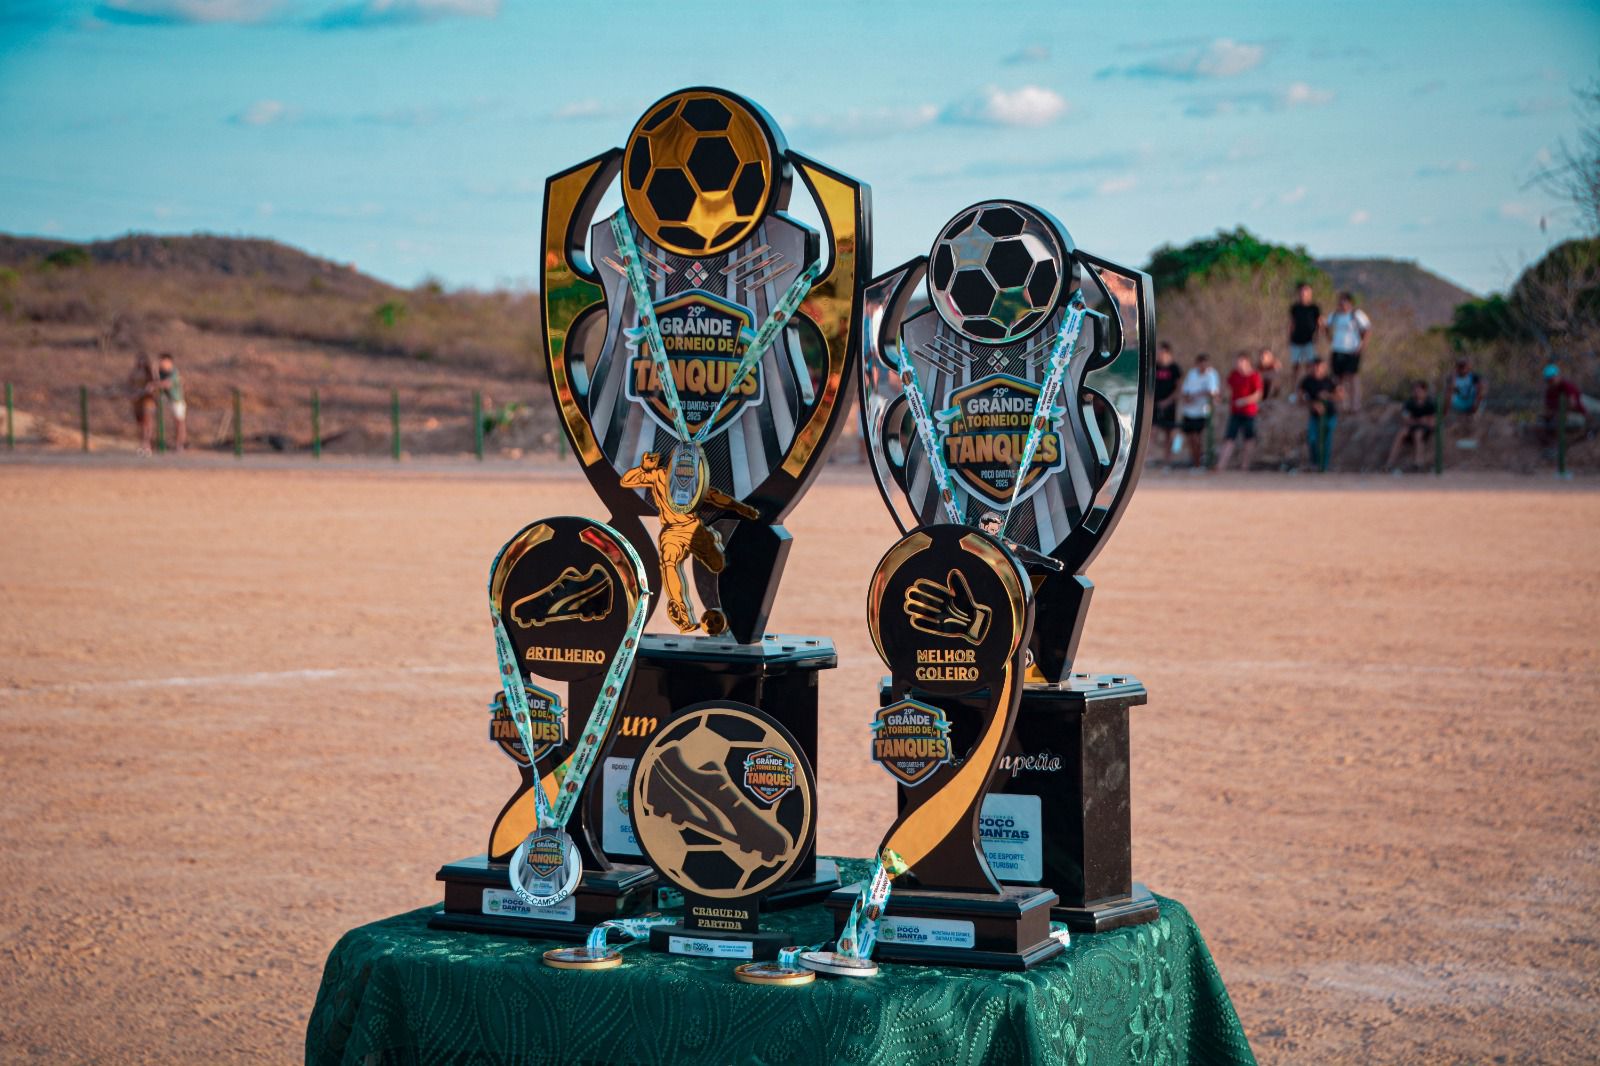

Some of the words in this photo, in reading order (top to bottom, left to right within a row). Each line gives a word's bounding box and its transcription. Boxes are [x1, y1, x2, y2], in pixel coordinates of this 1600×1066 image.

[660, 318, 732, 336] GRANDE
[663, 336, 716, 352] ORNEIO
[718, 338, 734, 352] DE
[633, 359, 758, 396] TANQUES
[967, 398, 1034, 414] GRANDE
[966, 414, 1018, 428] TORNEIO
[526, 646, 606, 664] ARTILHEIRO
[916, 649, 976, 664] MELHOR
[916, 666, 980, 682] GOLEIRO
[888, 714, 930, 725] GRANDE
[492, 720, 560, 742] TANUES
[888, 726, 921, 734] TORNEIO
[875, 738, 946, 759] TANQUES
[747, 772, 791, 786] TANQUES
[528, 854, 563, 864] TANQUES
[998, 853, 1025, 862] ESPORTE,
[692, 906, 732, 918] CRAQUE
[733, 910, 749, 919] DA
[698, 918, 742, 930] PARTIDA
